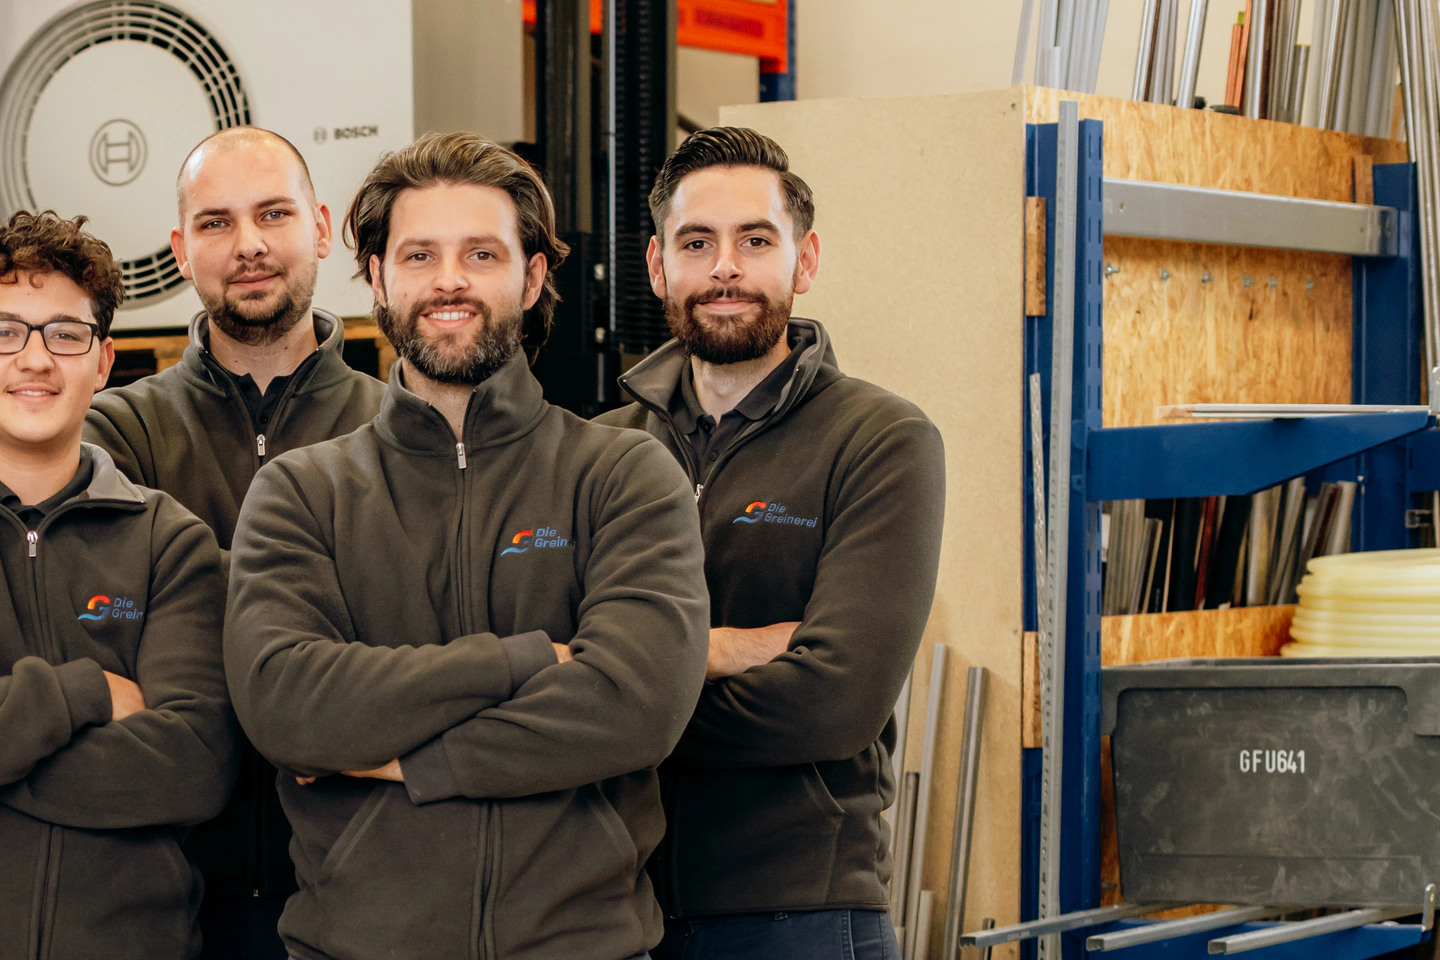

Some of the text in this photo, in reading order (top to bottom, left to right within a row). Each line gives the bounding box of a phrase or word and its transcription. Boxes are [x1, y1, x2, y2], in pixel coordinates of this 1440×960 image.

[333, 125, 378, 141] BOSCH
[767, 502, 787, 513] Die
[764, 512, 819, 528] Greinerei
[535, 526, 557, 538] Die
[113, 597, 134, 609] Die
[1239, 749, 1306, 774] GFU641
